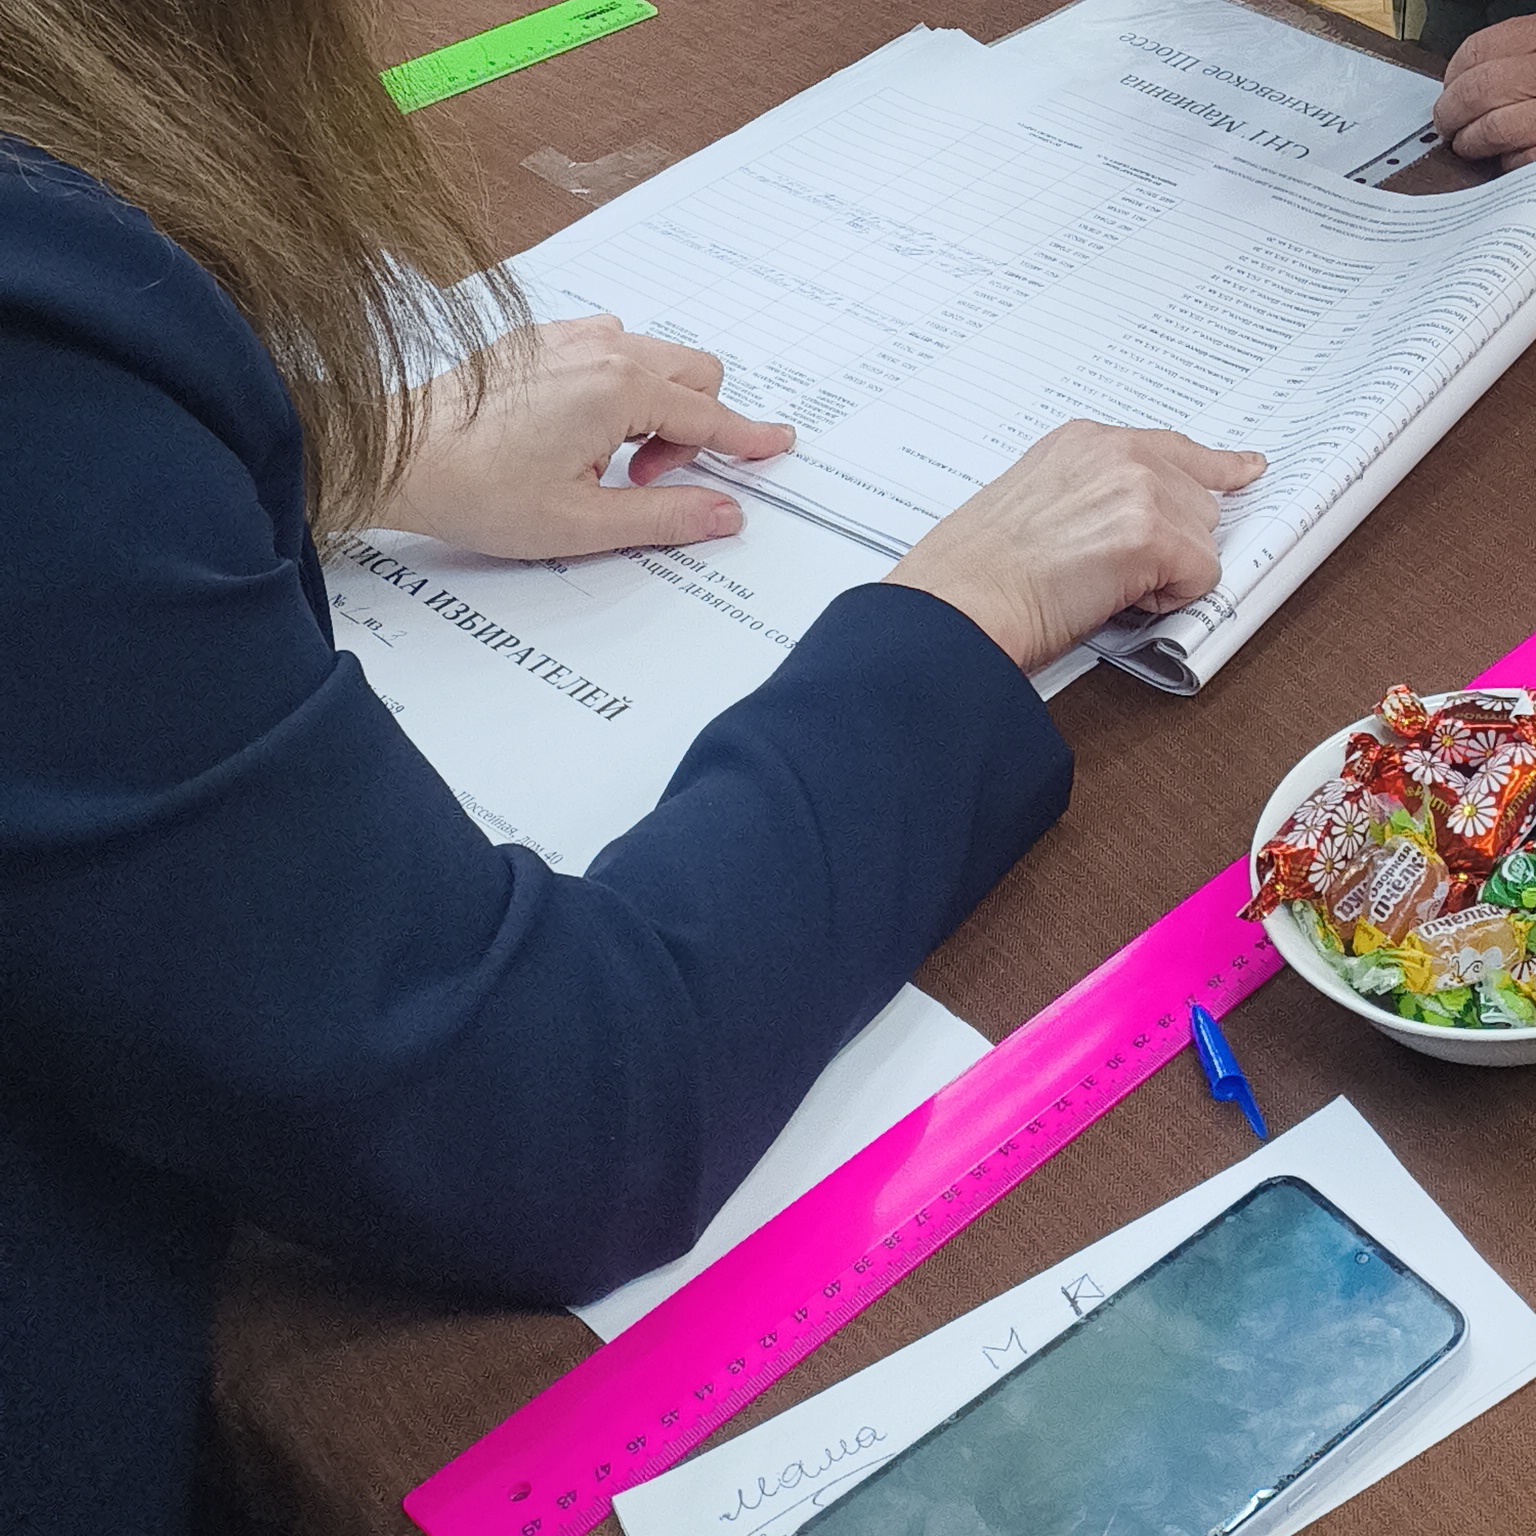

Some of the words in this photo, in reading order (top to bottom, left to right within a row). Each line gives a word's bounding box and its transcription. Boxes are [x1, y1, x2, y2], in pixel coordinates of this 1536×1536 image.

[1117, 29, 1202, 71] Шоссе
[1118, 72, 1247, 133] Марианна
[1203, 62, 1359, 136] Михневское
[652, 545, 708, 573] ННОЙ
[704, 570, 755, 600] ДУМЫ
[362, 617, 383, 631] из
[679, 582, 764, 631] ДЕВЯТОГО
[764, 628, 799, 650] СОЗ
[423, 589, 635, 722] ИЗБИРАТЕЛЕЙ
[455, 790, 518, 839] Шоссейная,
[544, 850, 564, 865] 40
[1255, 937, 1270, 951] 24
[1232, 956, 1246, 969] 25
[1207, 974, 1223, 988] 26
[1158, 1013, 1174, 1027] 28
[1133, 1034, 1149, 1048] 29
[1106, 1054, 1123, 1069] 30
[1079, 1075, 1097, 1091] 31
[1053, 1096, 1072, 1111] 32
[1025, 1118, 1043, 1134] 33
[998, 1140, 1016, 1155] 34
[970, 1163, 989, 1178] 35
[940, 1185, 960, 1201] 36
[912, 1209, 931, 1224] 37
[883, 1232, 902, 1248] 38
[852, 1257, 872, 1273] 39
[822, 1280, 843, 1297] 40
[791, 1307, 810, 1323] 41
[759, 1331, 780, 1347] 42
[727, 1356, 747, 1373] 43
[694, 1383, 714, 1399] 44
[660, 1408, 681, 1426] 45
[626, 1435, 648, 1452] 46
[592, 1462, 613, 1479] 47
[719, 1426, 888, 1522] мама
[556, 1490, 579, 1508] 48
[521, 1518, 543, 1533] 49
